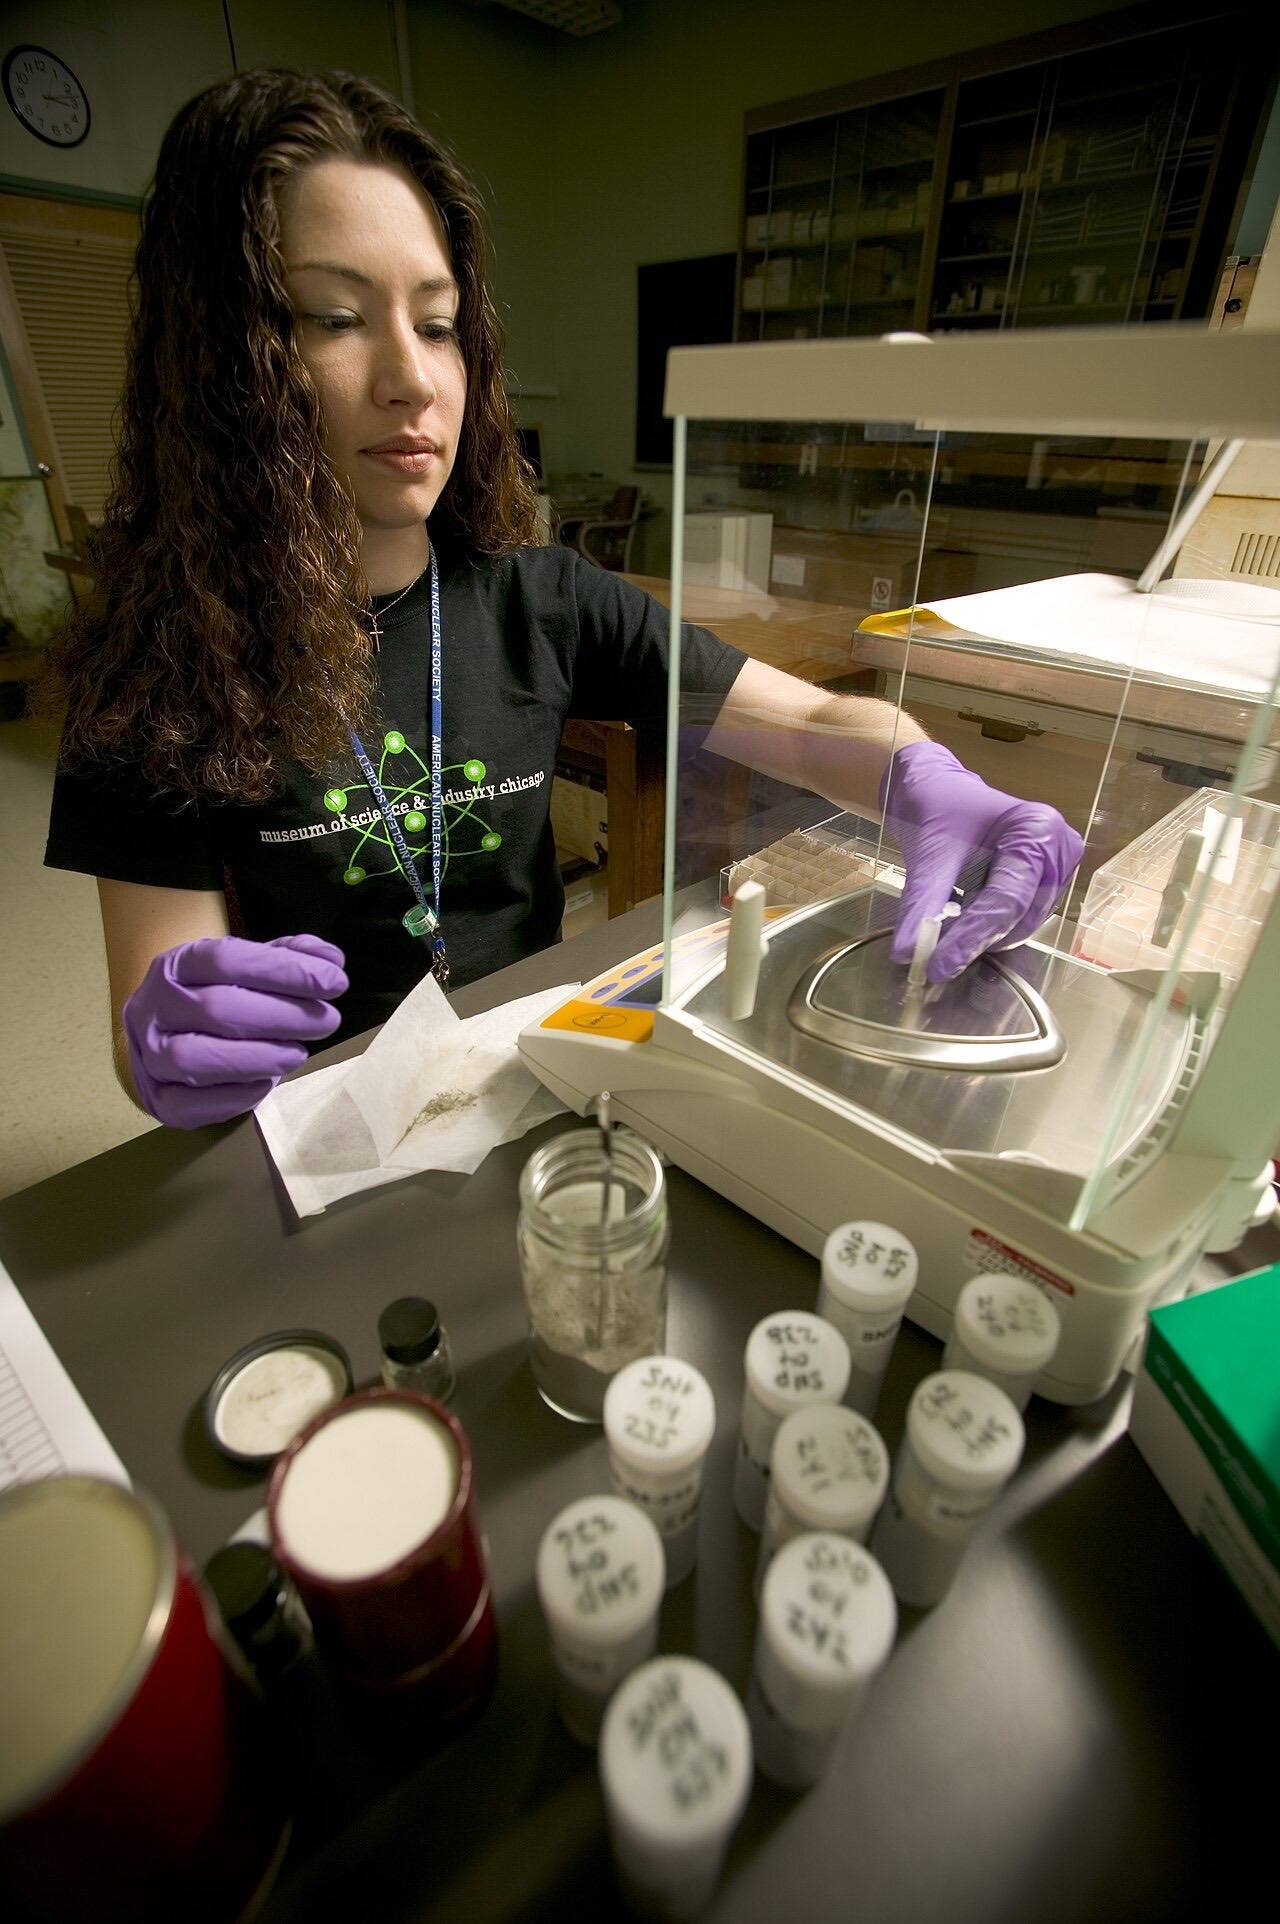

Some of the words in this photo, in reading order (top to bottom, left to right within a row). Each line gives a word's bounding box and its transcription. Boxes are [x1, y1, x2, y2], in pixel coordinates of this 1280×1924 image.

[431, 592, 441, 648] NUCLEAR
[431, 650, 442, 702] SOCIETY
[358, 755, 387, 804] SOCIETY
[431, 734, 441, 799] AMERICAN
[260, 822, 327, 842] museum
[330, 813, 349, 832] of
[350, 800, 411, 827] sciece
[413, 795, 427, 811] &
[499, 770, 545, 794] chicago
[382, 805, 411, 861] NUCLEAR
[431, 801, 441, 857] NUCLEAR
